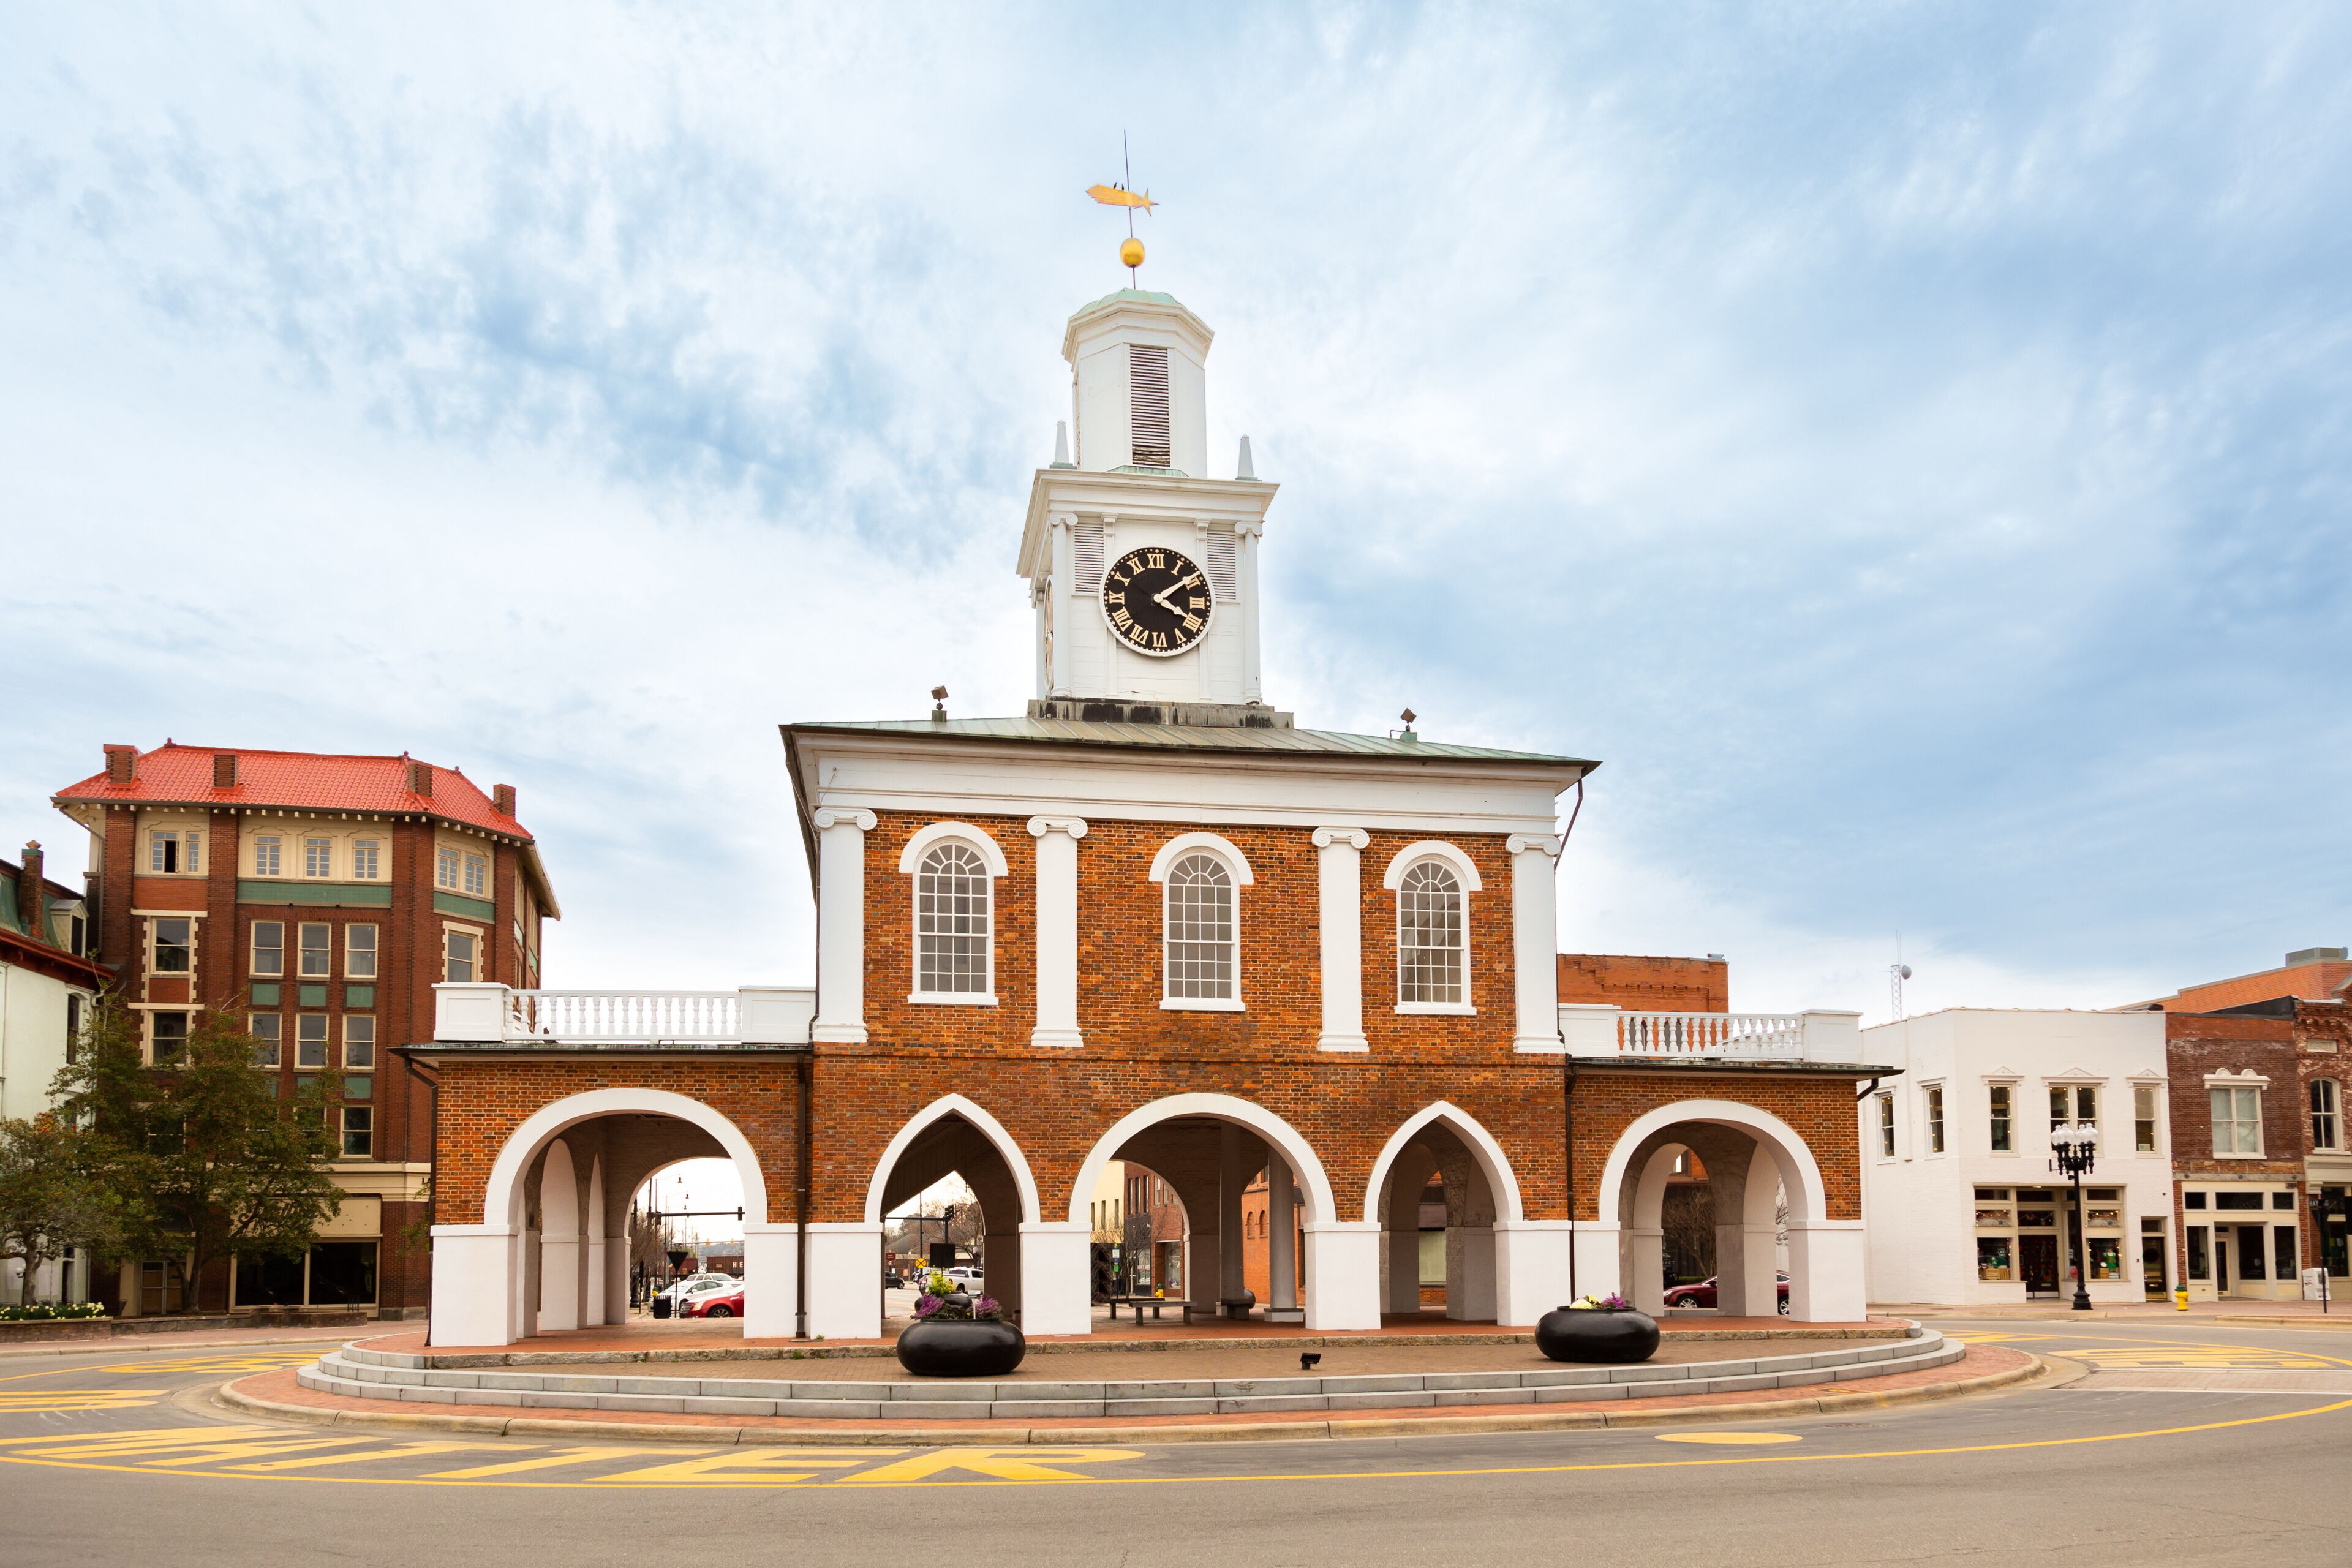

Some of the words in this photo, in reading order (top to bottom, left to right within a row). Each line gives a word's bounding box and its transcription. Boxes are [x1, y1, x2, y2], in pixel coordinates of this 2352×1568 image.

[1126, 557, 1145, 575] XI
[1147, 553, 1166, 568] XII
[1171, 559, 1184, 576] I
[1114, 571, 1131, 587] X
[1189, 596, 1205, 609] III
[1112, 606, 1134, 632] VIII
[1129, 624, 1150, 645] VII
[1152, 632, 1167, 647] VI
[1174, 628, 1187, 644] V
[0, 1424, 1147, 1483] MATTER
[2048, 1347, 2335, 1368] END
